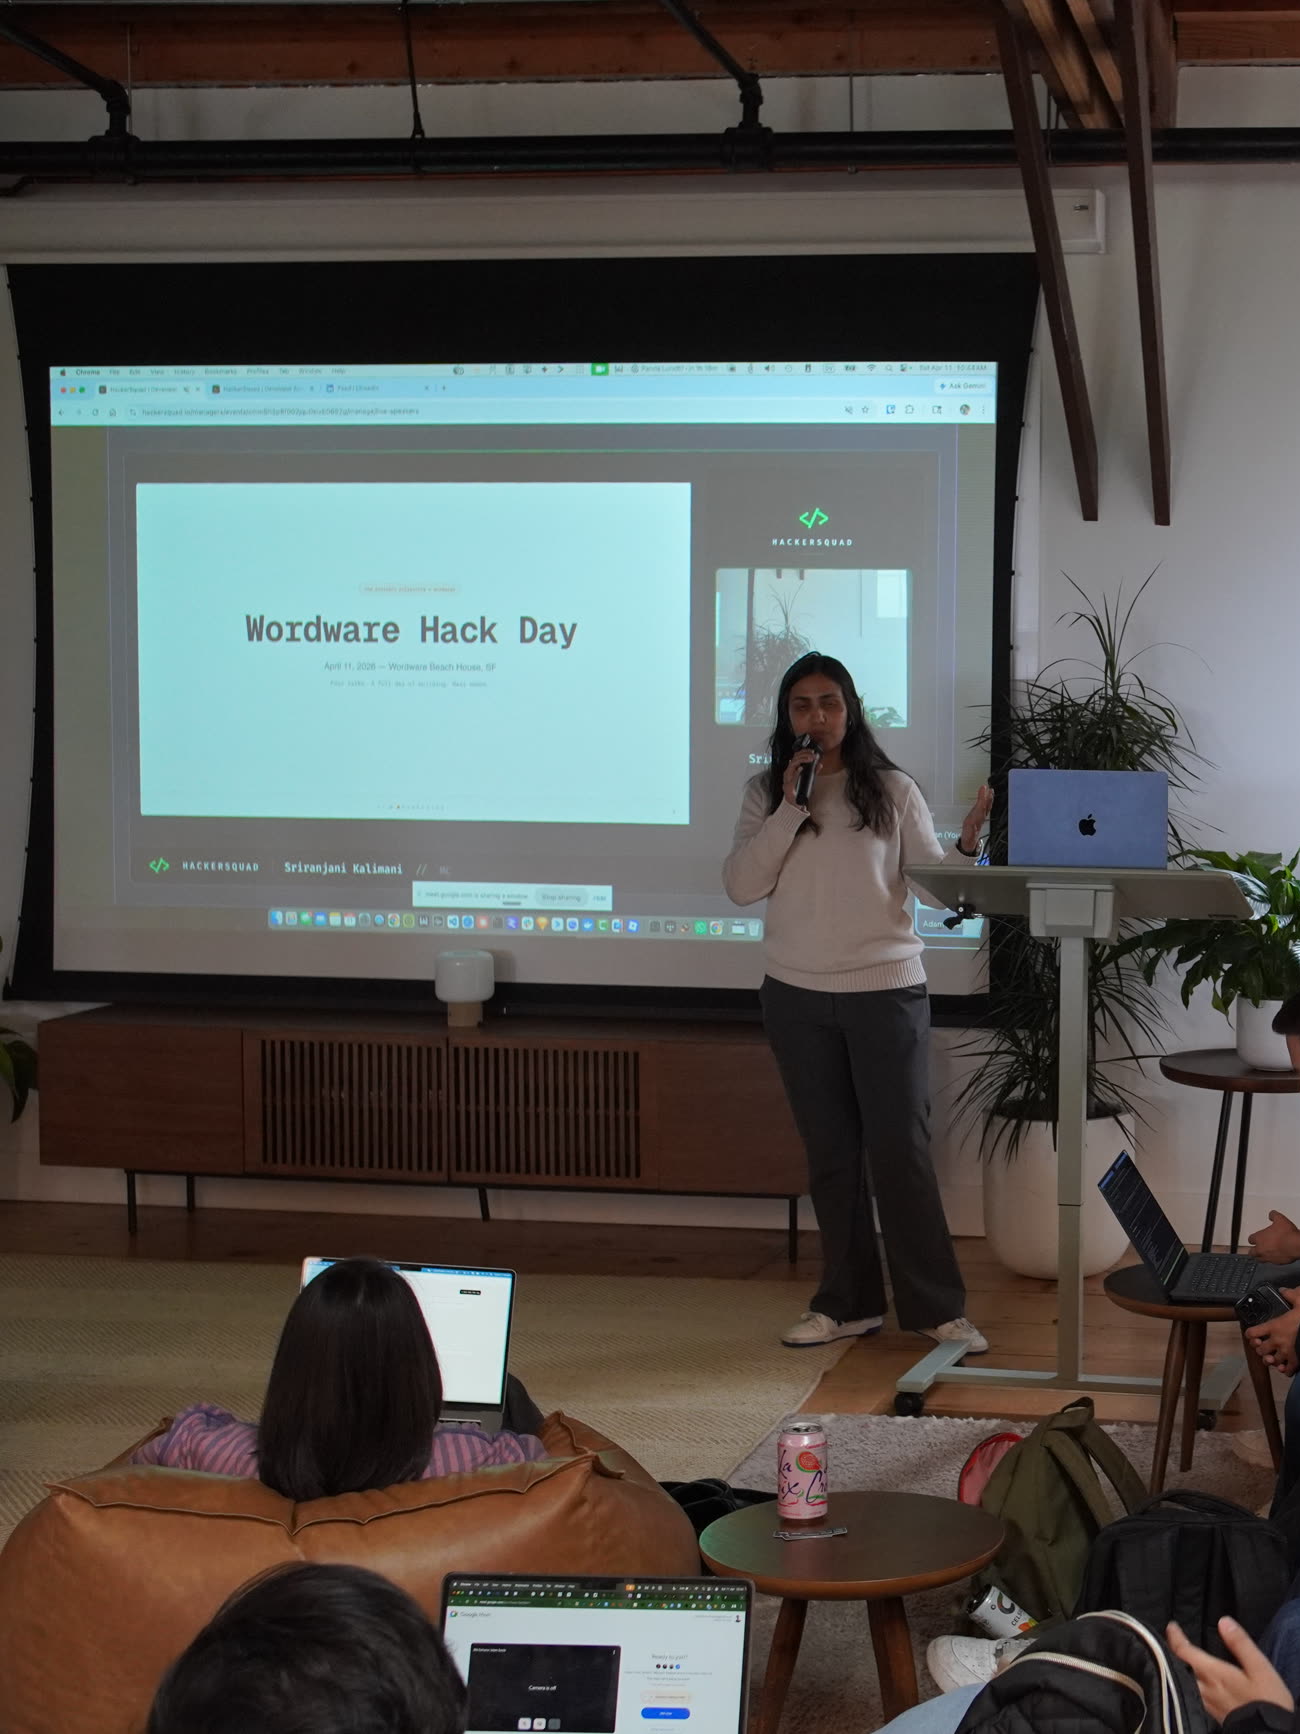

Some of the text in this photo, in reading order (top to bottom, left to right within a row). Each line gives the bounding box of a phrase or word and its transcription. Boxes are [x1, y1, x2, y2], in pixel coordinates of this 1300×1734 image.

[772, 538, 852, 547] HACKERSQUAD
[246, 614, 578, 650] Wordware Hack Day
[324, 662, 342, 672] April
[344, 662, 354, 672] 11,
[356, 662, 376, 671] 2026
[388, 662, 427, 672] Wordware
[430, 662, 454, 672] Beach
[456, 662, 483, 672] House,
[486, 663, 496, 672] SF
[182, 861, 403, 876] HACKERSQUAD Sriranjani Kalimani
[542, 894, 556, 902] Stop
[558, 894, 581, 904] sharing
